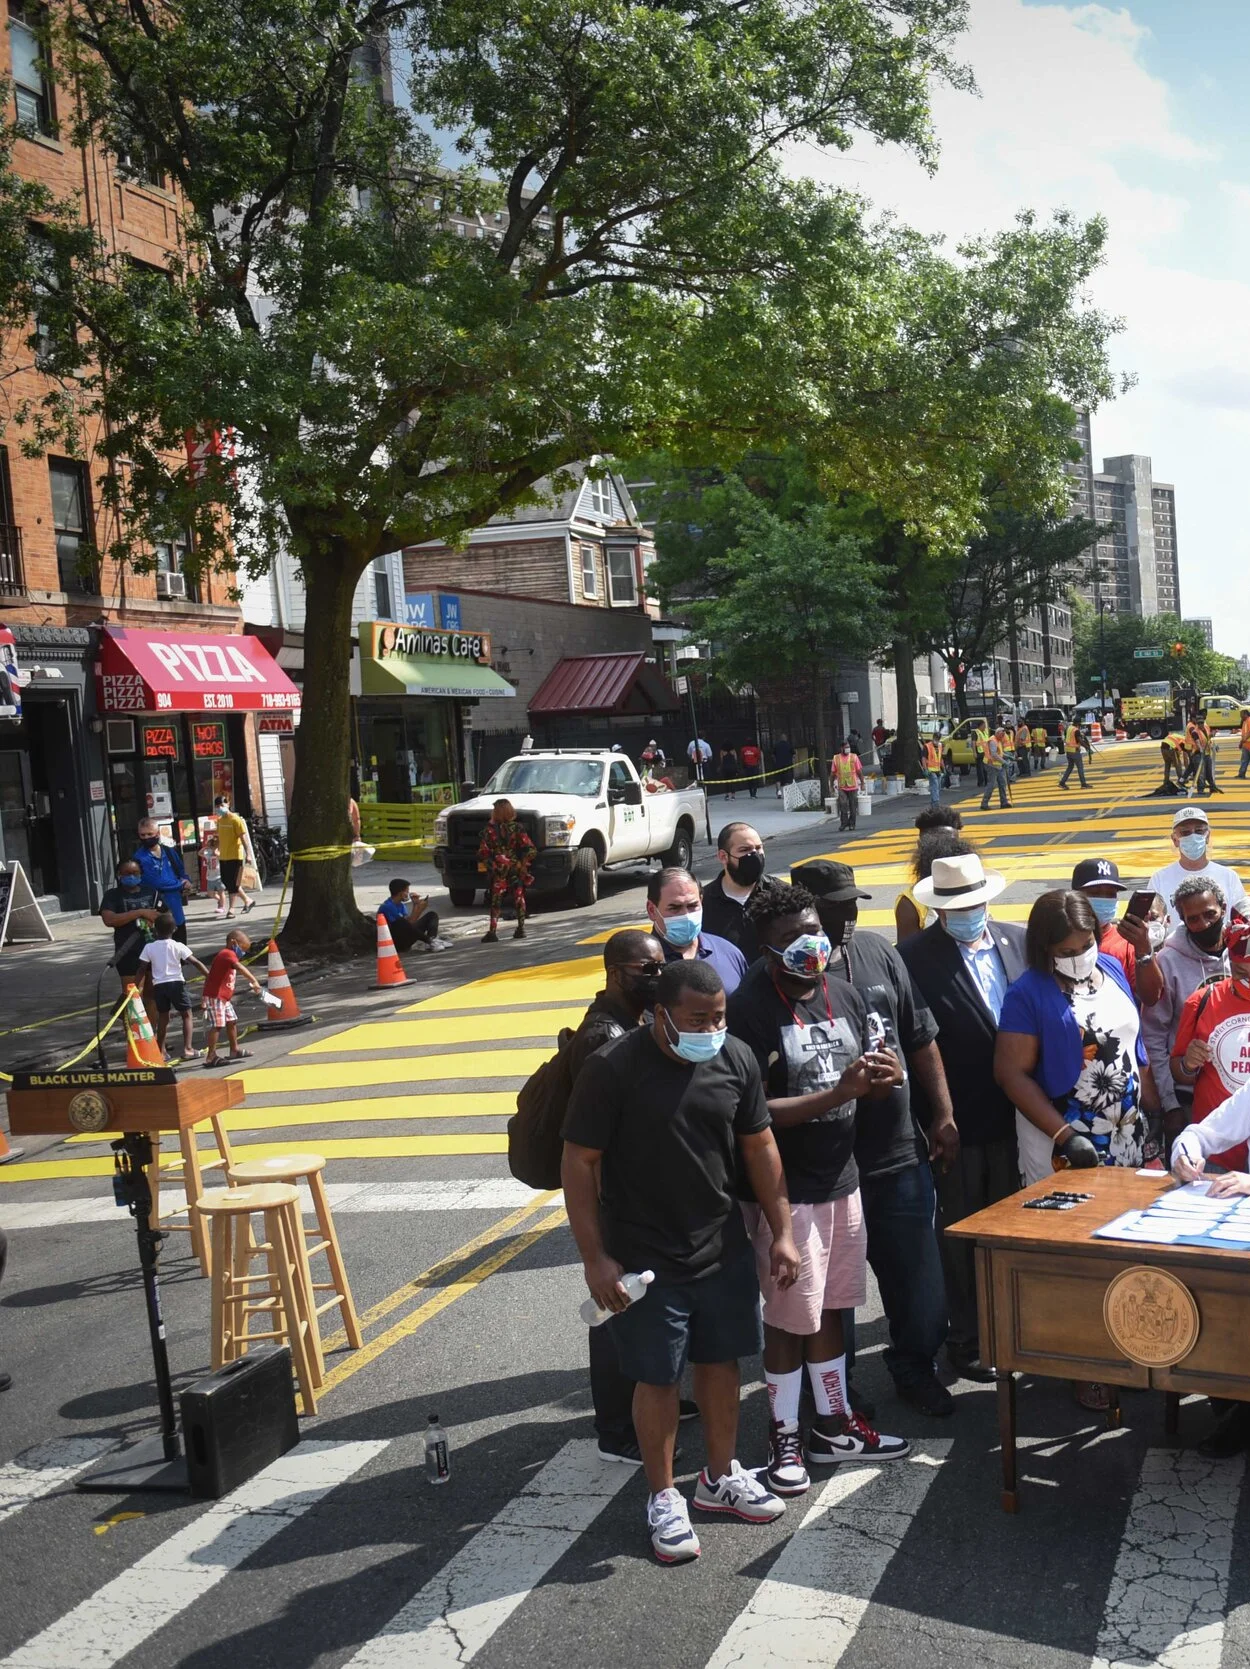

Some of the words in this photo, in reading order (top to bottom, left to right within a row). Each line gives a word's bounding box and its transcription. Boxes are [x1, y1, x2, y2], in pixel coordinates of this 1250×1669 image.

[447, 604, 457, 619] JW
[147, 642, 267, 682] PIZZA
[102, 675, 144, 686] PIZZA
[103, 686, 145, 698] PIZZA
[104, 698, 146, 709] PIZZA
[157, 693, 172, 708] 904
[218, 694, 233, 708] 2010
[196, 725, 217, 740] HOT
[259, 720, 293, 731] ATM
[146, 729, 174, 743] PIZZA
[146, 746, 177, 758] PASTA
[193, 741, 224, 755] HEROS
[1248, 1032, 1250, 1042] I
[30, 1075, 68, 1085] BLACK
[71, 1073, 104, 1084] LIVES
[107, 1071, 155, 1082] MATTER
[820, 1369, 846, 1415] MARATHON
